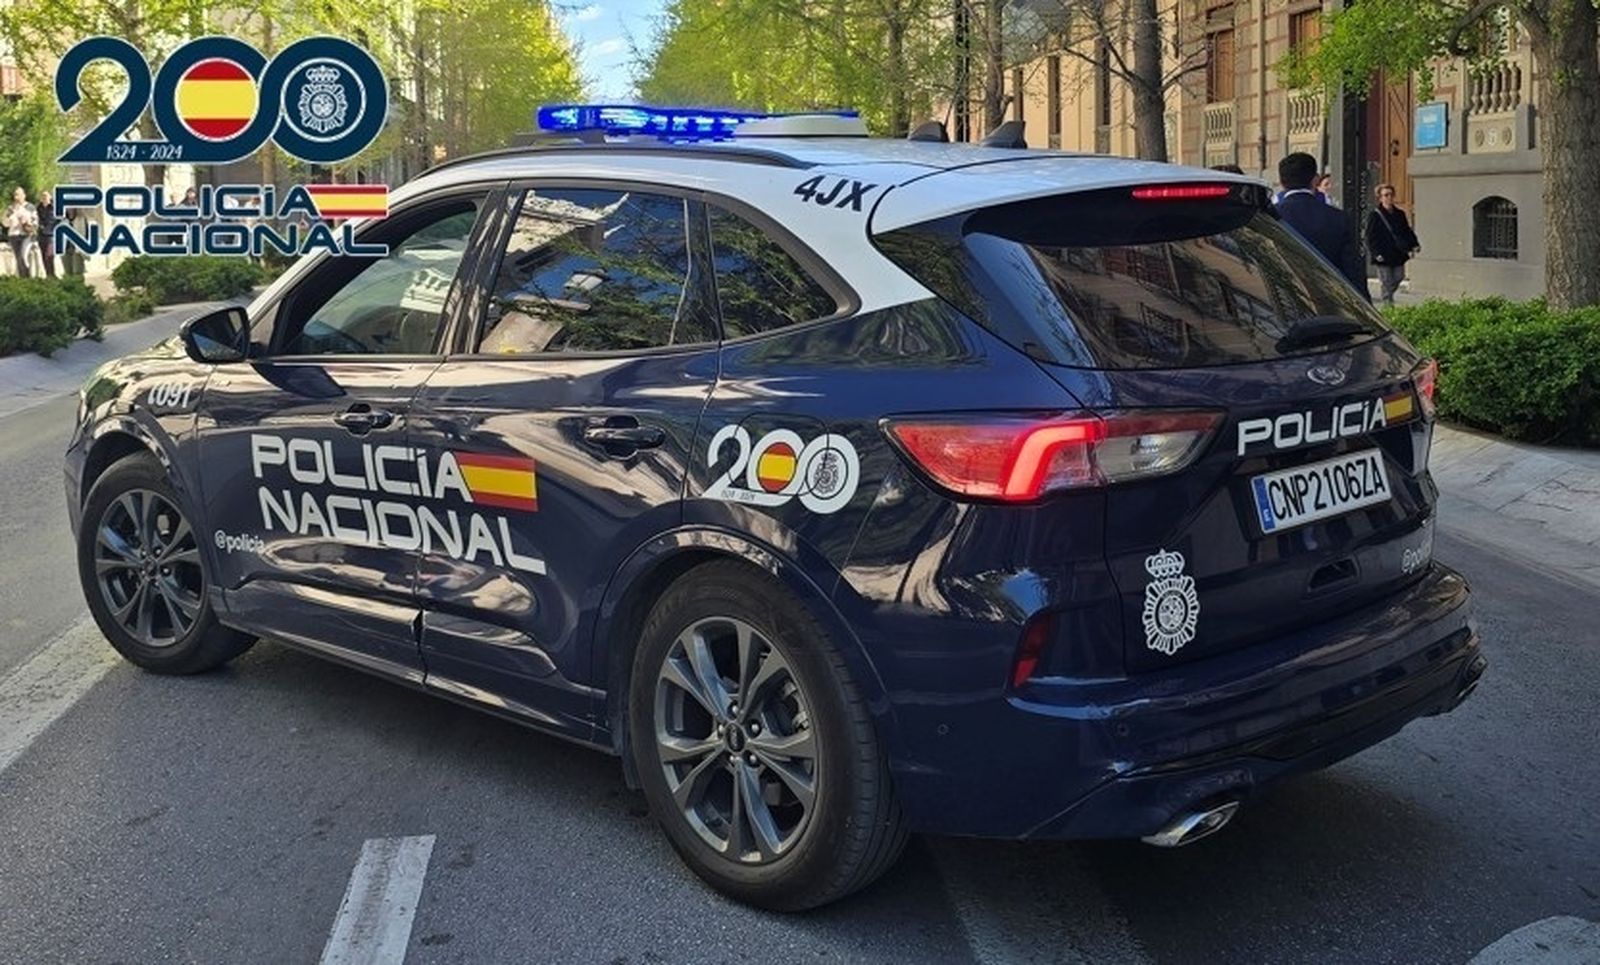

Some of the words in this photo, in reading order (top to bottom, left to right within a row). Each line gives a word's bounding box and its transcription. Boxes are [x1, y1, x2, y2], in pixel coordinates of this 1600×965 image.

[794, 175, 877, 212] 4JX
[700, 424, 861, 514] 200
[1268, 455, 1386, 521] CNP2106ZA
[258, 486, 547, 576] NACIONAL
